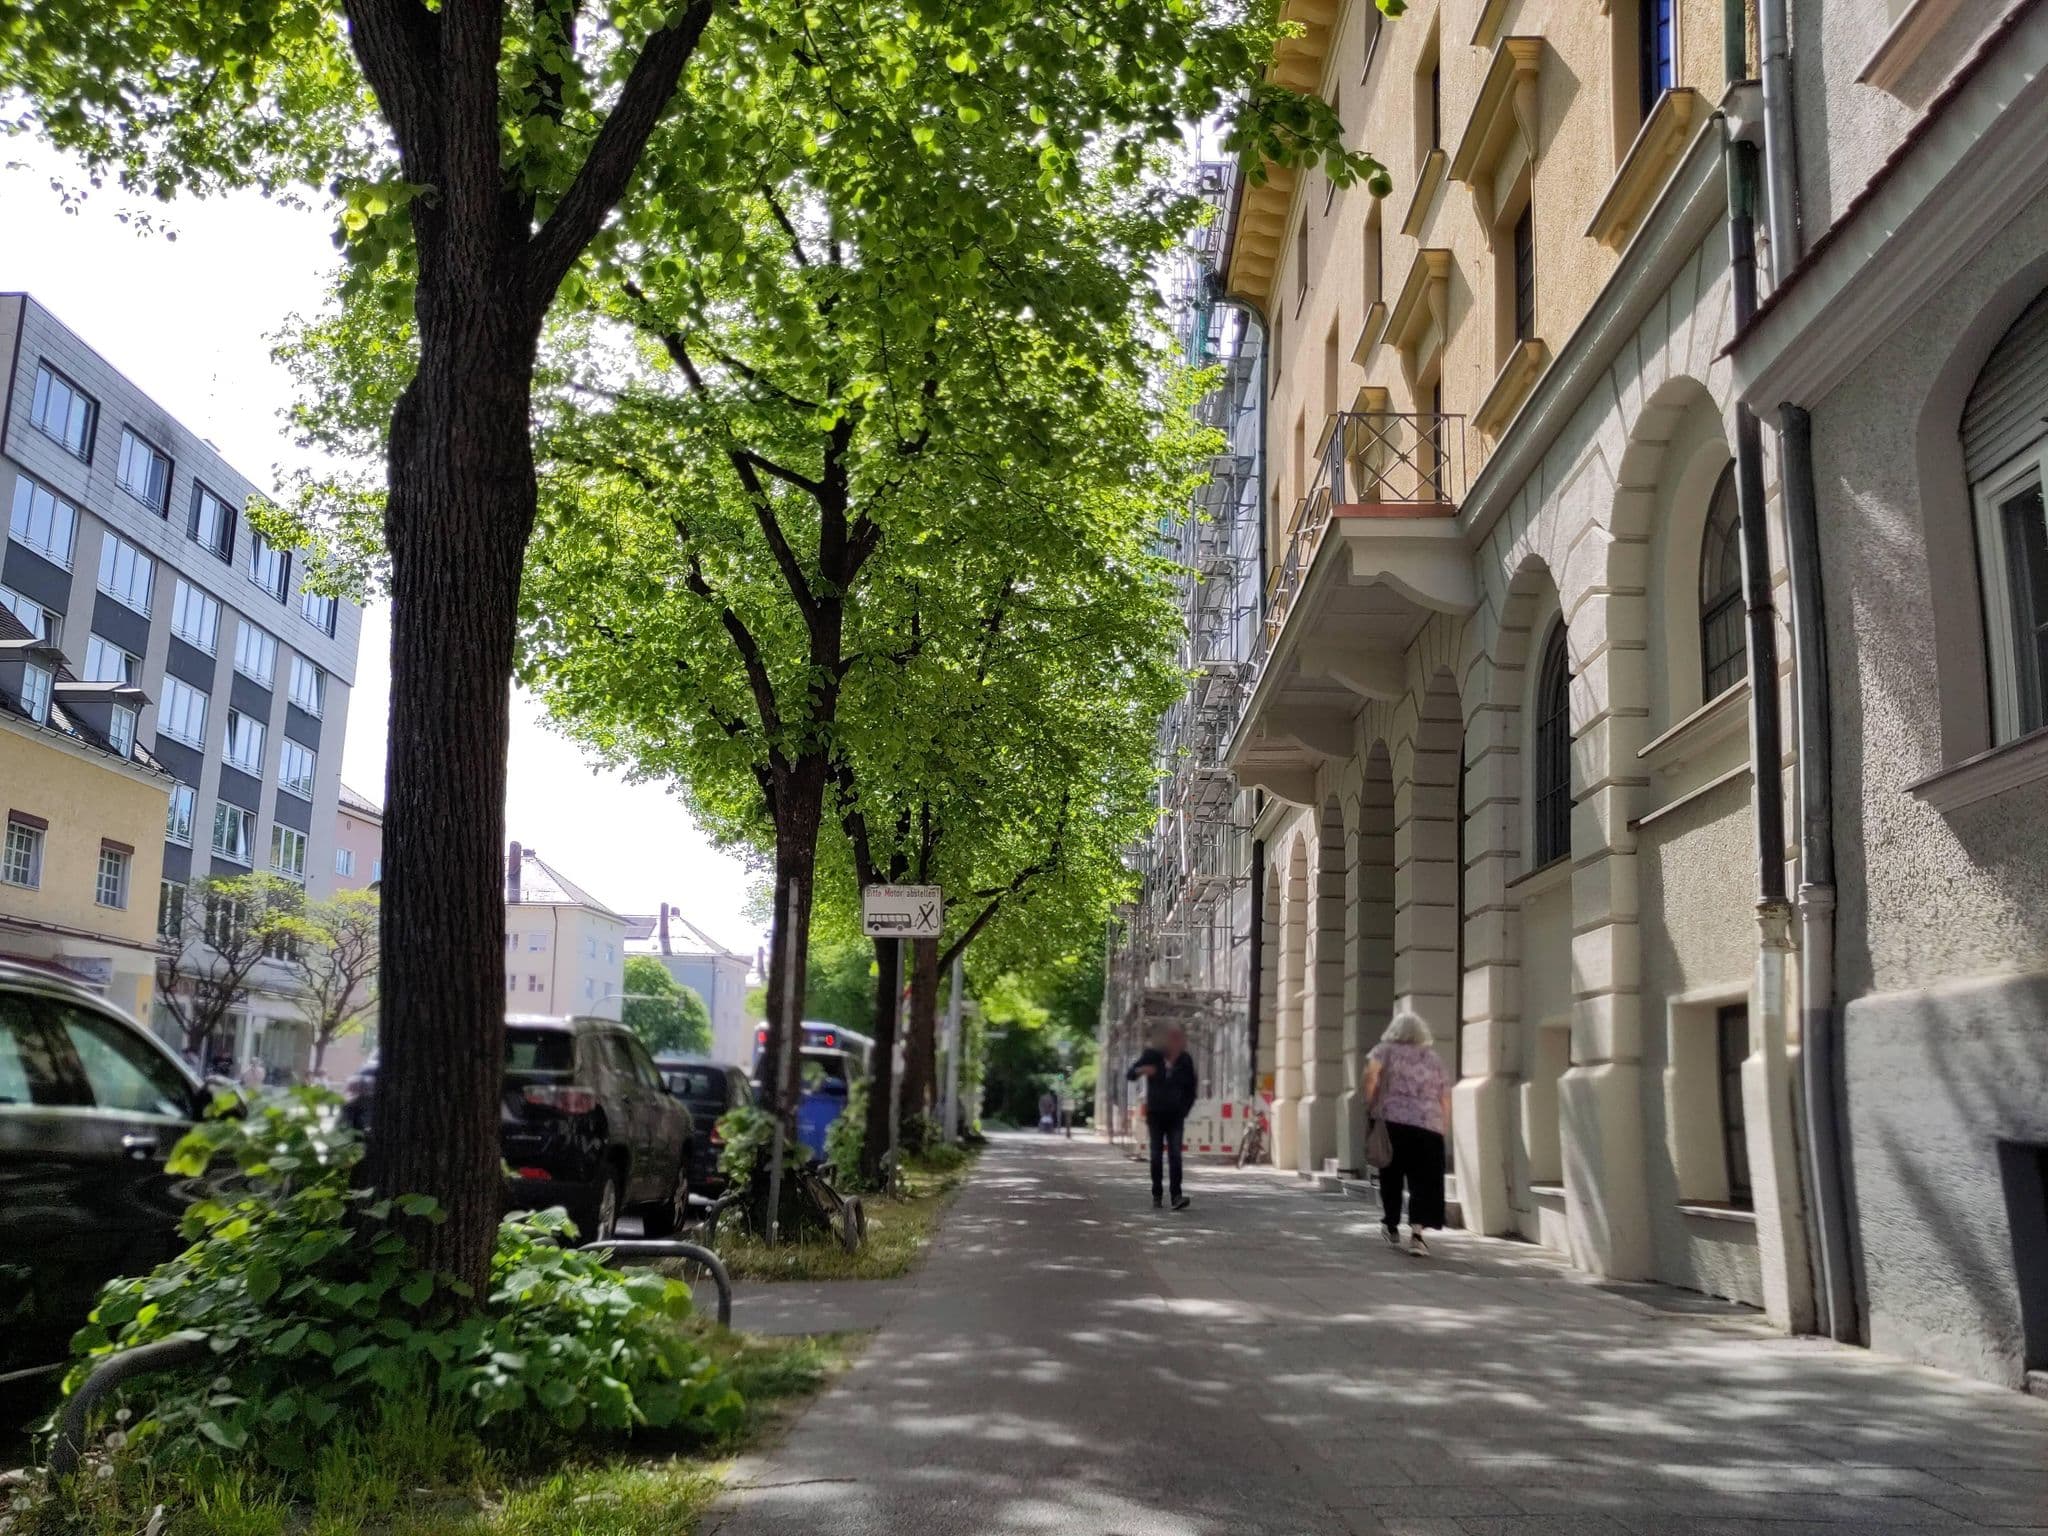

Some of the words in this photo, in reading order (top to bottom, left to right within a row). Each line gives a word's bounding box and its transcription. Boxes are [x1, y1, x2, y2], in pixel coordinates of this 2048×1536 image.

[866, 889, 881, 897] Bitte
[884, 888, 903, 897] Motor
[906, 888, 939, 898] abstellen!
